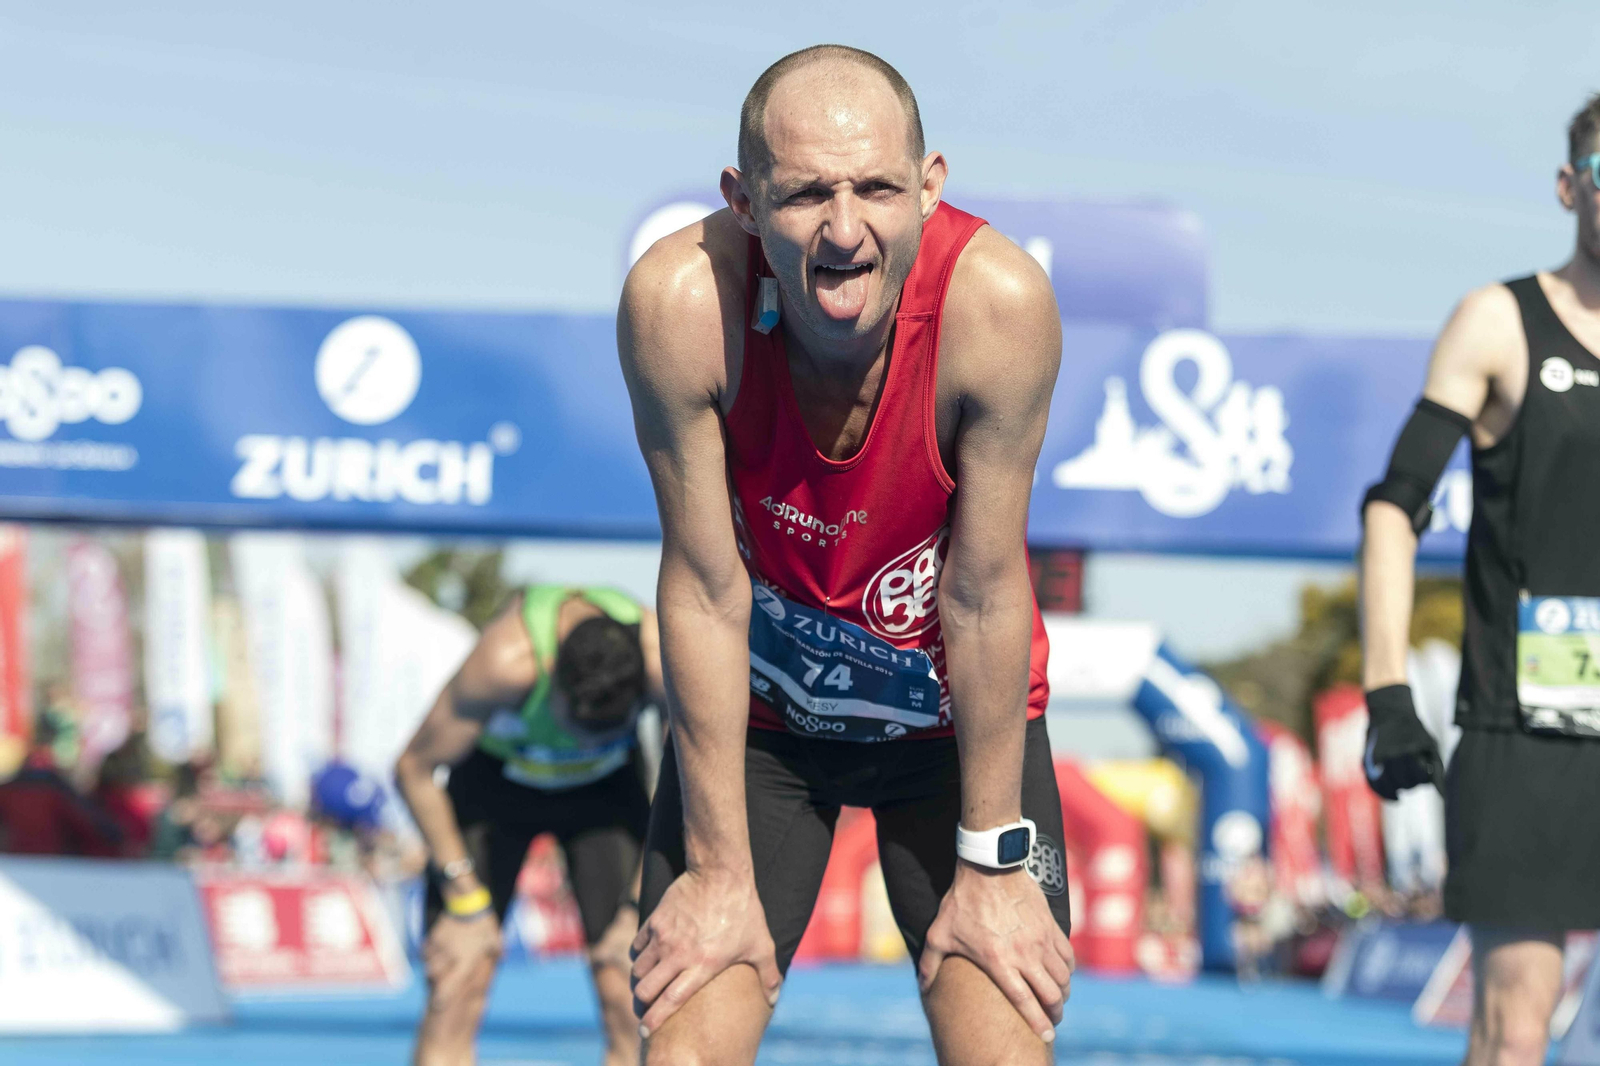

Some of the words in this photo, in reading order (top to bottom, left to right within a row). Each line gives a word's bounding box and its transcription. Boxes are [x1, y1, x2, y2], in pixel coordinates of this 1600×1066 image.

[230, 434, 493, 505] ZURICH
[772, 519, 848, 548] SPORTS
[793, 614, 912, 668] ZURICH
[801, 654, 854, 691] 74
[845, 654, 873, 670] SEVILLA
